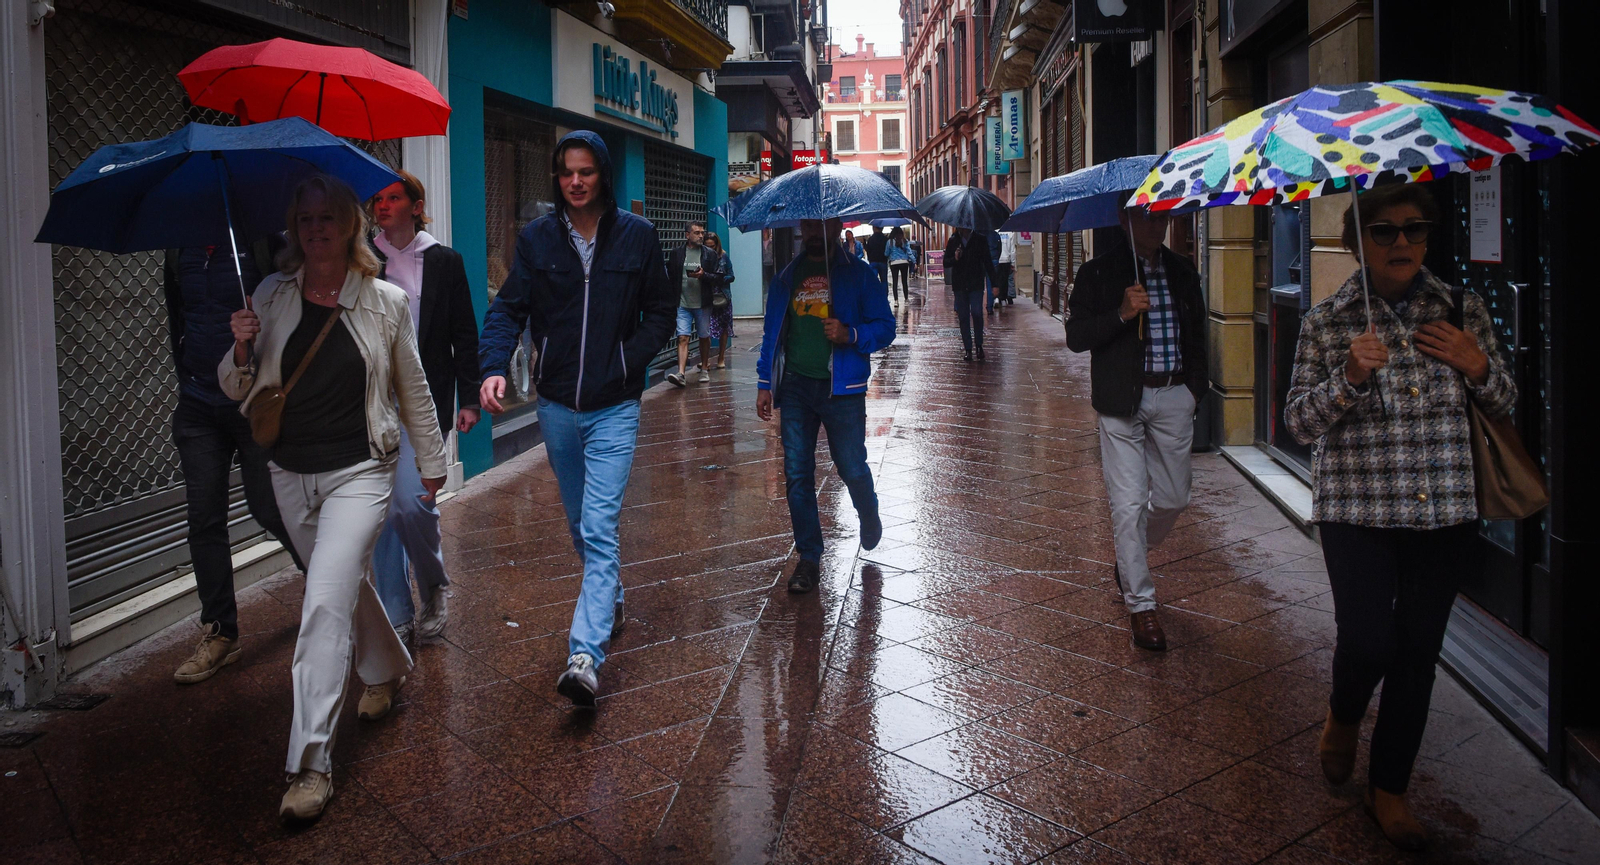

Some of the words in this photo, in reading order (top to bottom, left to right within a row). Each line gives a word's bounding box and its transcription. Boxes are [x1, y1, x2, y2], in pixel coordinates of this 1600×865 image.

[1081, 28, 1114, 36] Premium
[593, 43, 639, 110] Little
[993, 121, 1001, 170] PERFUMERÍA
[1009, 96, 1018, 153] Aromas
[794, 155, 824, 163] fotoprx
